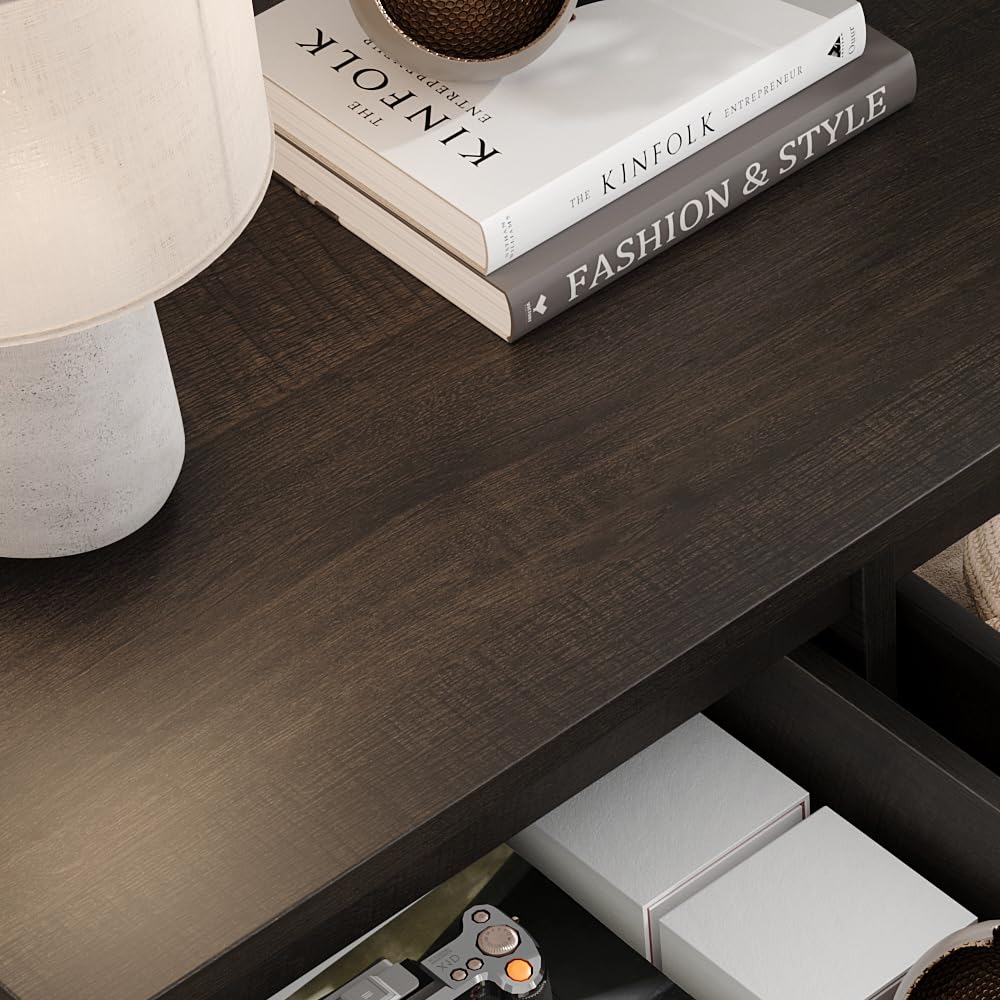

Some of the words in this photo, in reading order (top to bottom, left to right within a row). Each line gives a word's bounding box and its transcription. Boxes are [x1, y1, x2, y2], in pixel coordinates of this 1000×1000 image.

[295, 27, 503, 167] KINFOLK
[347, 100, 385, 127] THE
[569, 189, 591, 208] THE
[601, 111, 715, 195] KINFOLK
[723, 65, 803, 118] ENTREPRENEUR
[566, 178, 731, 302] FASHION
[742, 161, 770, 196] &
[778, 85, 887, 175] STYLE
